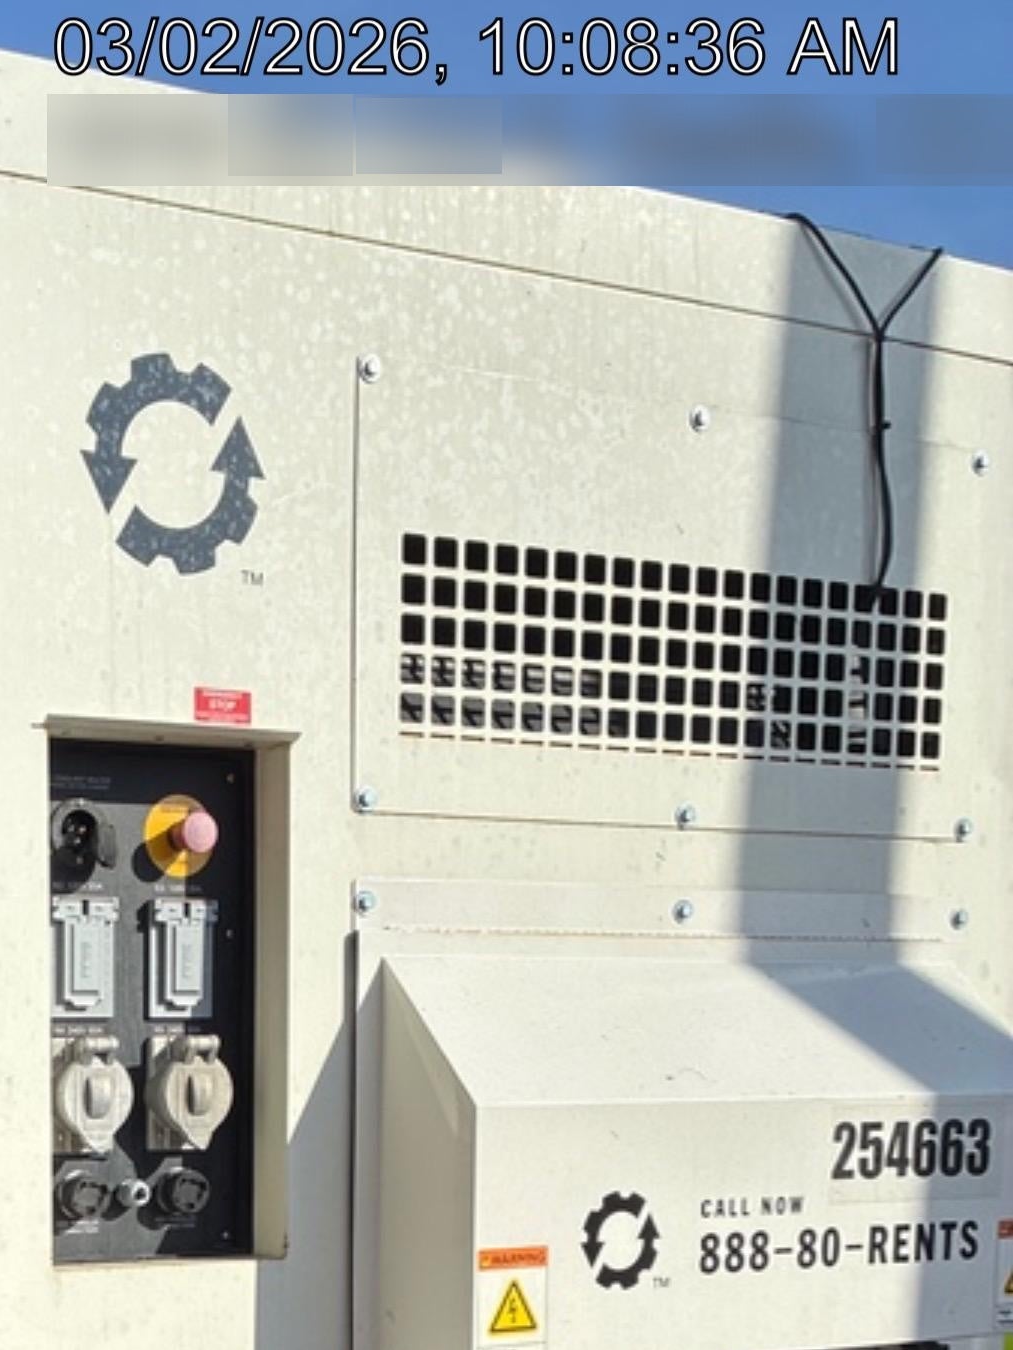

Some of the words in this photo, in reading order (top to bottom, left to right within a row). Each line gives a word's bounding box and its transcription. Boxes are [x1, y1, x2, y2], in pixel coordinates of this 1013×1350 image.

[831, 1118, 992, 1180] 254663
[700, 1199, 750, 1219] CALL
[760, 1196, 805, 1217] NOW
[699, 1219, 979, 1275] 888-80-RENTS
